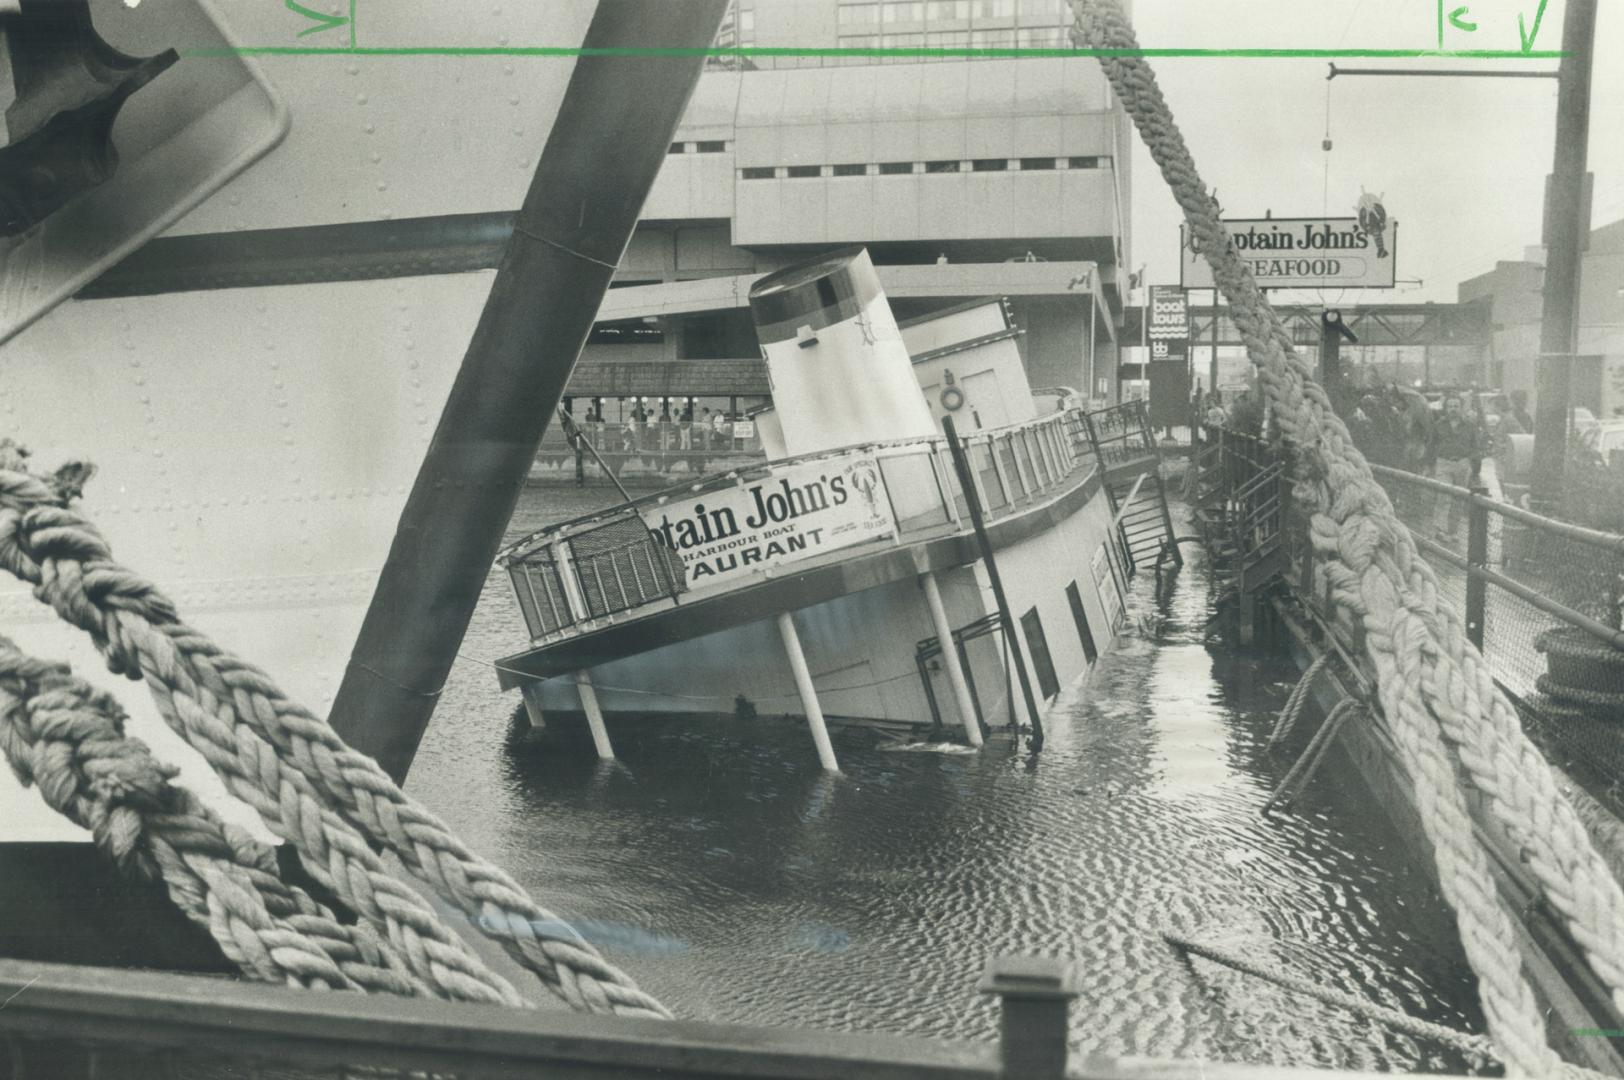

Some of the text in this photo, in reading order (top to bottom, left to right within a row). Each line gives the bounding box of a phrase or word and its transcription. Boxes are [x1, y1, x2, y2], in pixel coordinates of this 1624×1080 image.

[1232, 225, 1369, 250] ptain John's
[1153, 299, 1186, 312] boat
[1153, 312, 1186, 325] tours
[746, 474, 849, 529] John's
[684, 523, 797, 562] HARBOUR BOAT
[686, 528, 824, 581] AURANT
